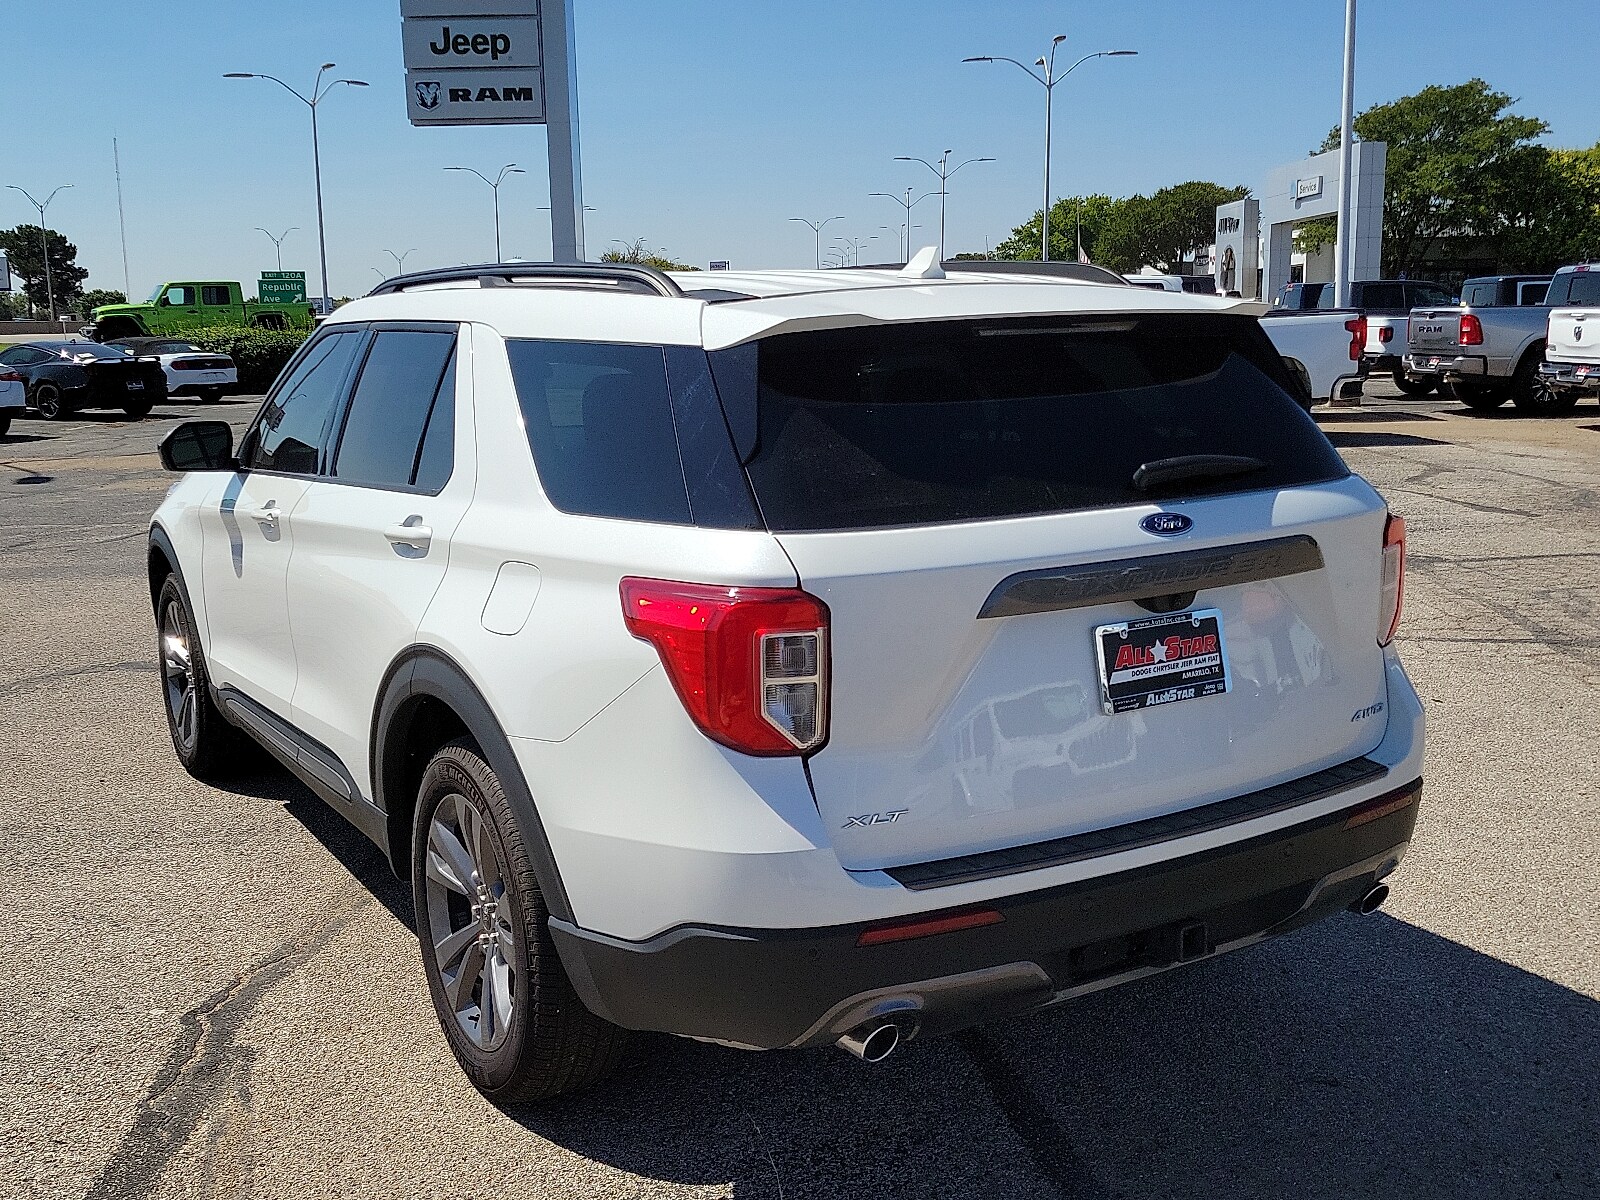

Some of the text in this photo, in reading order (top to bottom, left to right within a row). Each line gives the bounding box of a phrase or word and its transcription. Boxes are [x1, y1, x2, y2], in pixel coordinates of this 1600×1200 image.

[429, 26, 511, 61] Jeep
[448, 87, 533, 102] RAM
[262, 283, 302, 292] Republic
[263, 295, 281, 303] Ave
[1418, 325, 1443, 333] RAM
[1154, 515, 1184, 531] Ford
[1131, 667, 1152, 678] DODGE
[1152, 662, 1180, 673] CHRYSLER
[1194, 656, 1207, 665] RAM
[1207, 654, 1219, 662] FIAT
[1212, 665, 1220, 673] TX
[449, 767, 485, 812] MICHELIN
[840, 808, 911, 829] XLT
